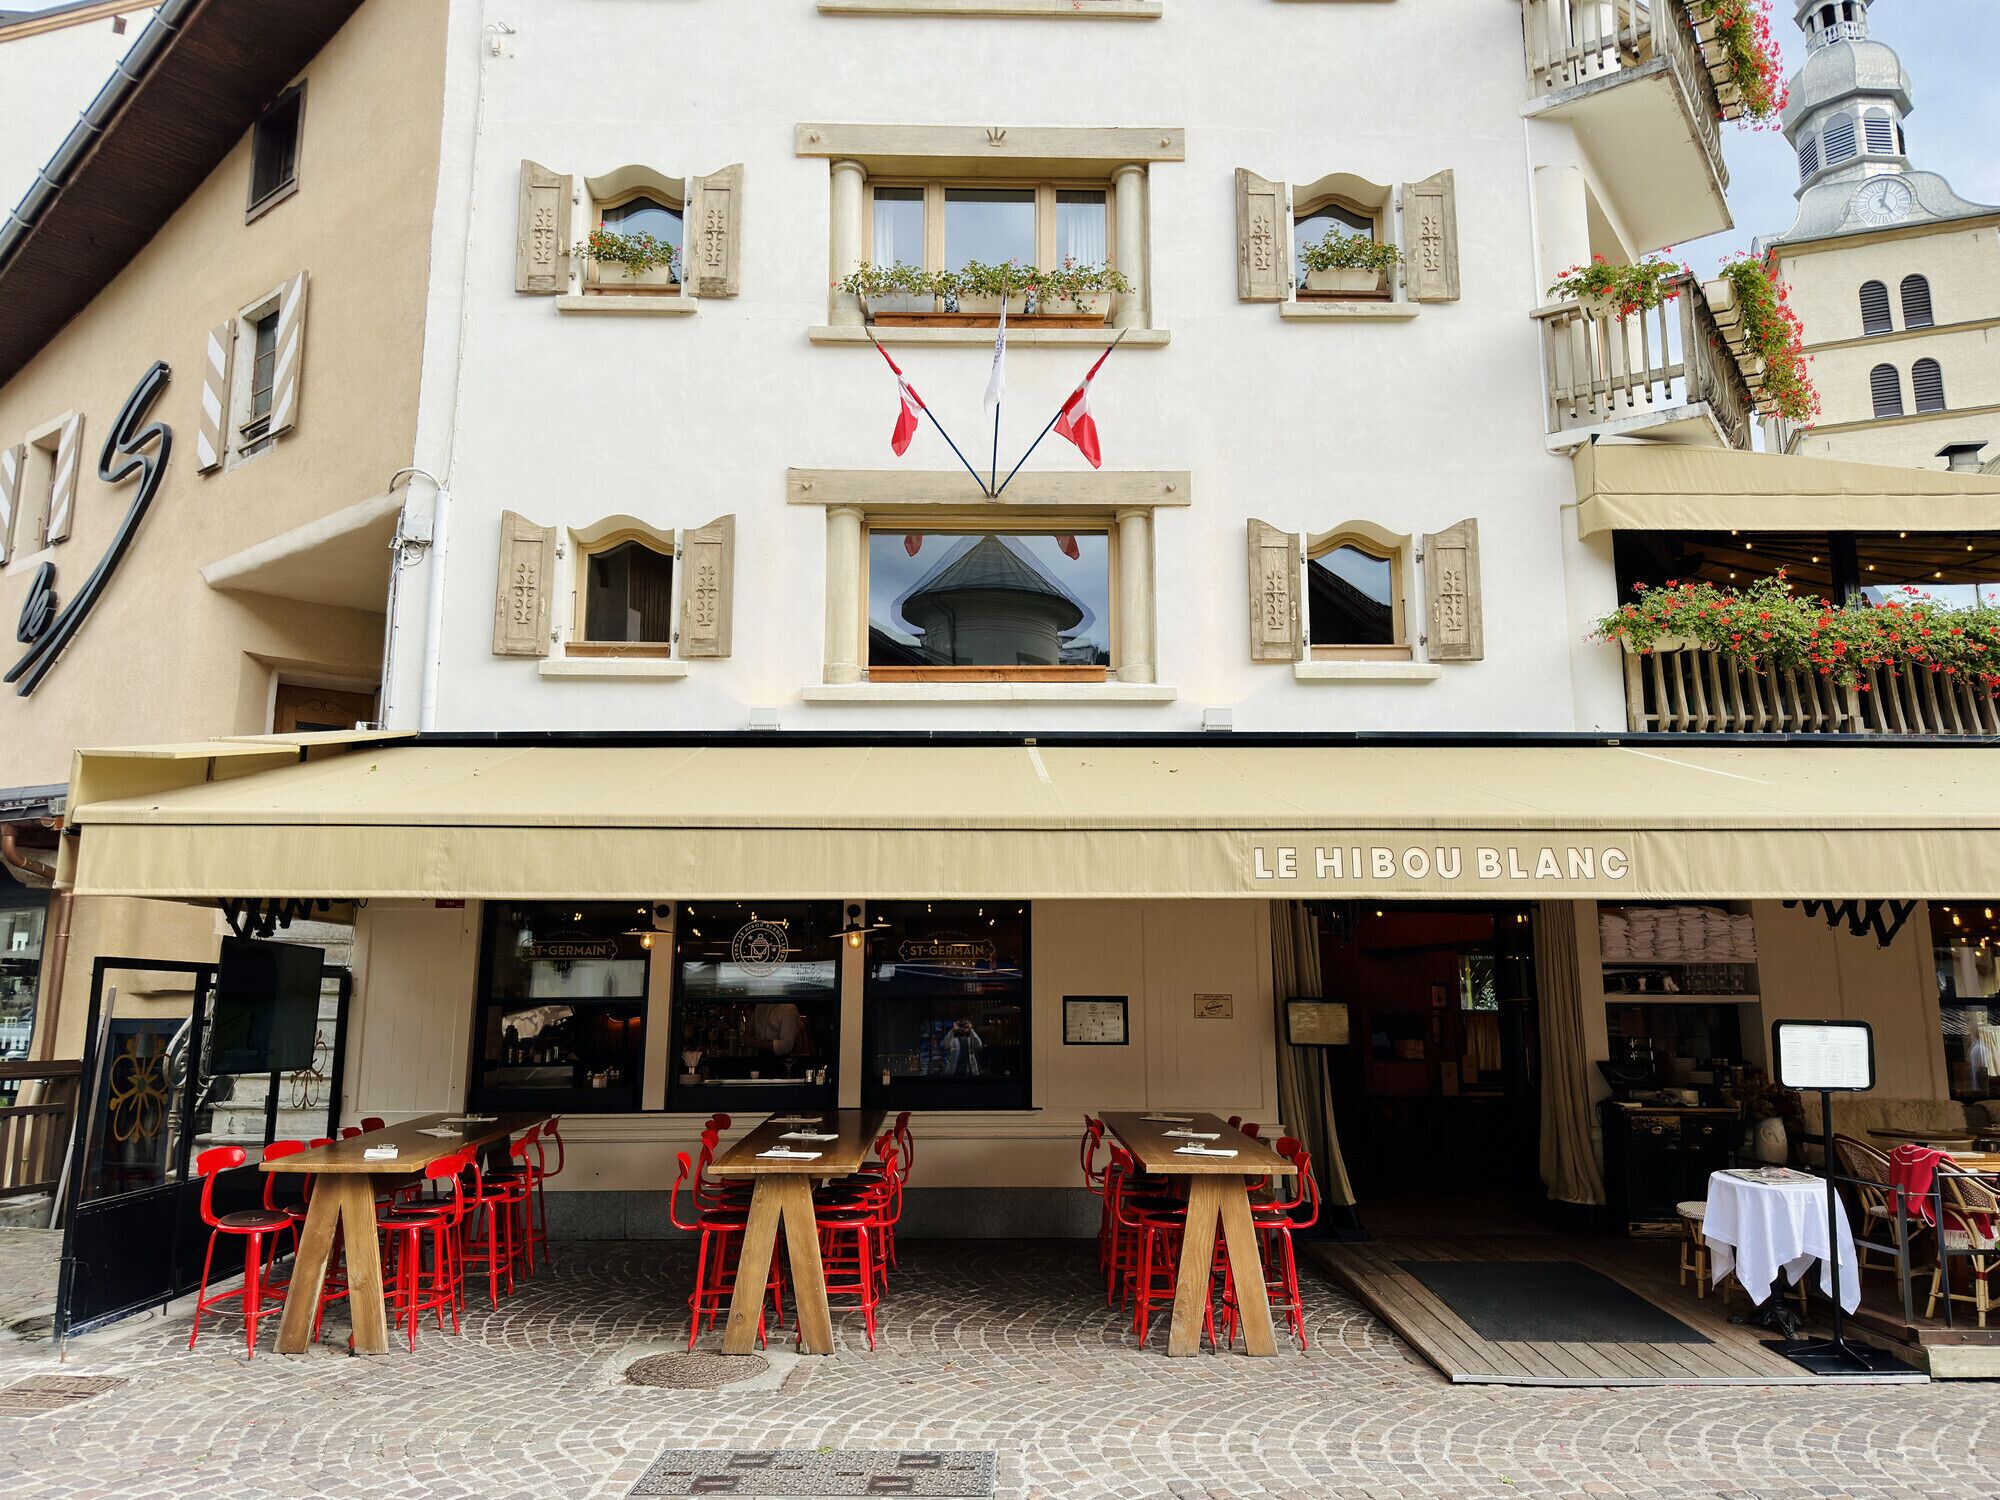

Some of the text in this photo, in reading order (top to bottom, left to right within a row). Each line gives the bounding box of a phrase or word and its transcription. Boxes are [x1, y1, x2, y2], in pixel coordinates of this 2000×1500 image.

[1254, 847, 1629, 879] LE HIBOU BLANC
[744, 923, 763, 932] HIBOU
